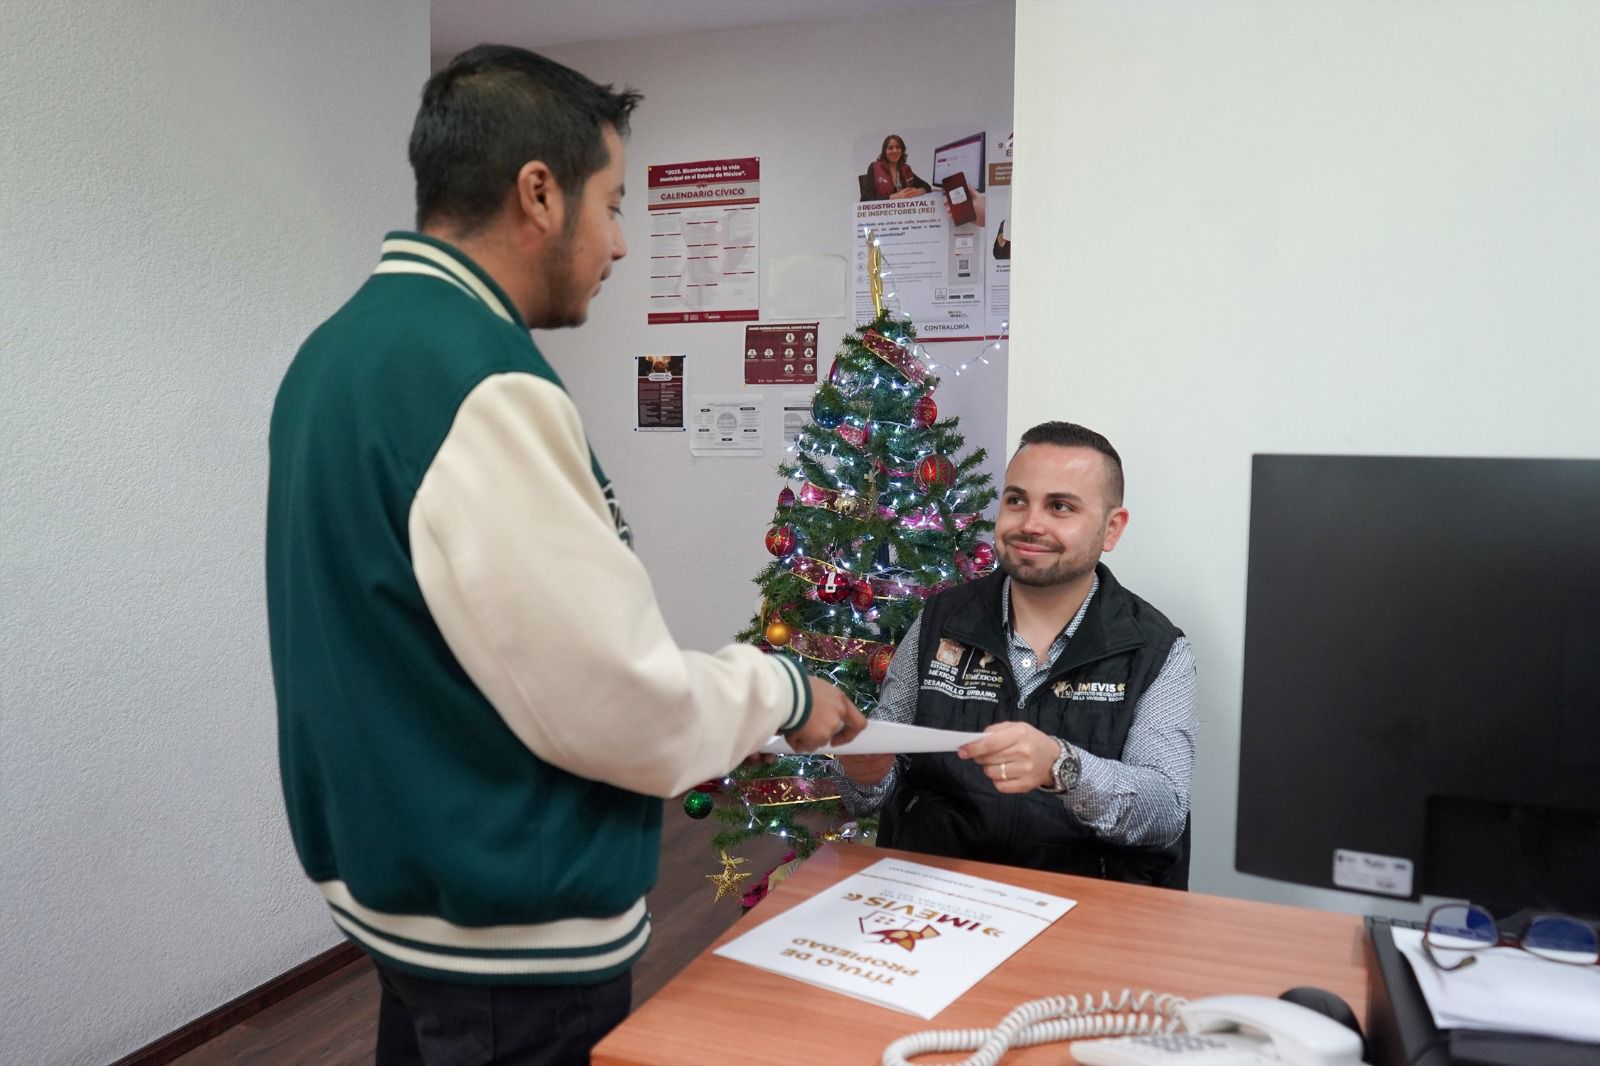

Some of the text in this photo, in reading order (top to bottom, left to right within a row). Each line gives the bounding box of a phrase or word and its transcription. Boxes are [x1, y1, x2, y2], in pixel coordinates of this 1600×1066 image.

[661, 187, 744, 200] CALENDARIO CÍVICO
[897, 200, 928, 208] ESTATAL
[868, 209, 916, 217] INSPECTORES
[924, 323, 969, 331] CONTRALORÍA
[928, 669, 955, 682] MÉXICO
[1078, 682, 1116, 692] IMEVIS
[966, 689, 996, 698] URBANO
[863, 895, 983, 932] IMEVIS
[791, 936, 920, 977] PROPIEDAD
[781, 948, 896, 987] TÍTULO DE
